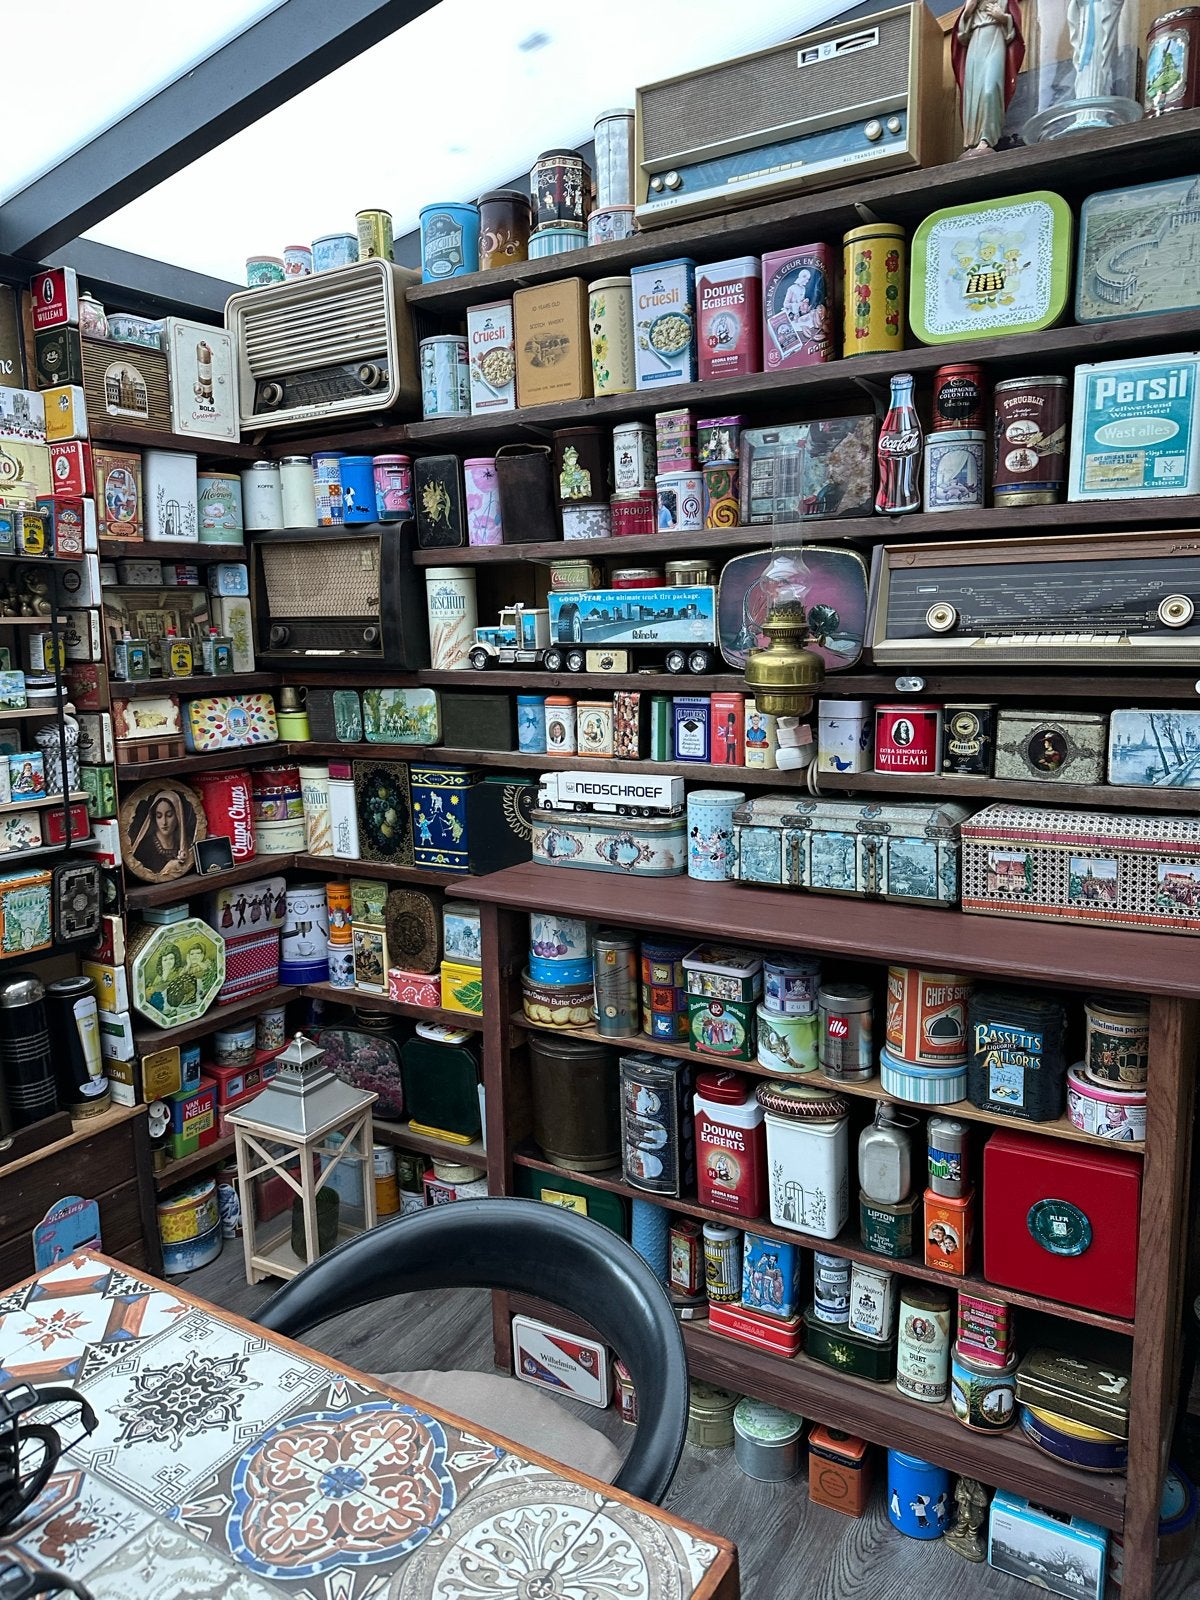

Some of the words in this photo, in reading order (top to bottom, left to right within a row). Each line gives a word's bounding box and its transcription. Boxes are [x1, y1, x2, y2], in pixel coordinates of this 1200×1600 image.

[652, 199, 678, 208] PHILIPS
[773, 275, 782, 284] AL
[781, 259, 802, 274] GEUR
[639, 287, 679, 310] Cruesli
[704, 282, 743, 299] DOUWE
[702, 294, 745, 310] EGBERTS
[473, 326, 505, 345] Cruesli
[939, 391, 978, 400] COLONIALE
[941, 386, 975, 395] COMPAGNIE
[1095, 368, 1188, 410] Persil
[199, 404, 215, 412] BOLS
[1003, 395, 1045, 409] TERUGBLIK
[1103, 427, 1136, 440] Wast
[1138, 424, 1171, 436] alles
[430, 594, 466, 610] BESCHUIT
[879, 754, 920, 766] WILLEM
[921, 755, 928, 766] II
[575, 782, 663, 798] NEDSCHROEF
[228, 785, 246, 820] Chups
[231, 821, 249, 857] Chupa
[925, 985, 953, 1007] CHEF'S
[829, 1020, 847, 1037] illy
[974, 1023, 1042, 1056] BASSETT'S
[986, 1043, 1017, 1051] LIQUORICE
[980, 1049, 1041, 1070] ALLSORTS
[185, 1099, 200, 1111] VAN
[185, 1101, 211, 1119] NELLE
[702, 1122, 743, 1141] DOUWE
[700, 1132, 746, 1152] EGBERTS
[867, 1209, 895, 1223] LIPTON
[869, 1236, 881, 1244] Earl
[932, 1259, 954, 1270] 2002
[540, 1352, 577, 1372] Wilhelmina
[909, 1352, 927, 1363] DUET
